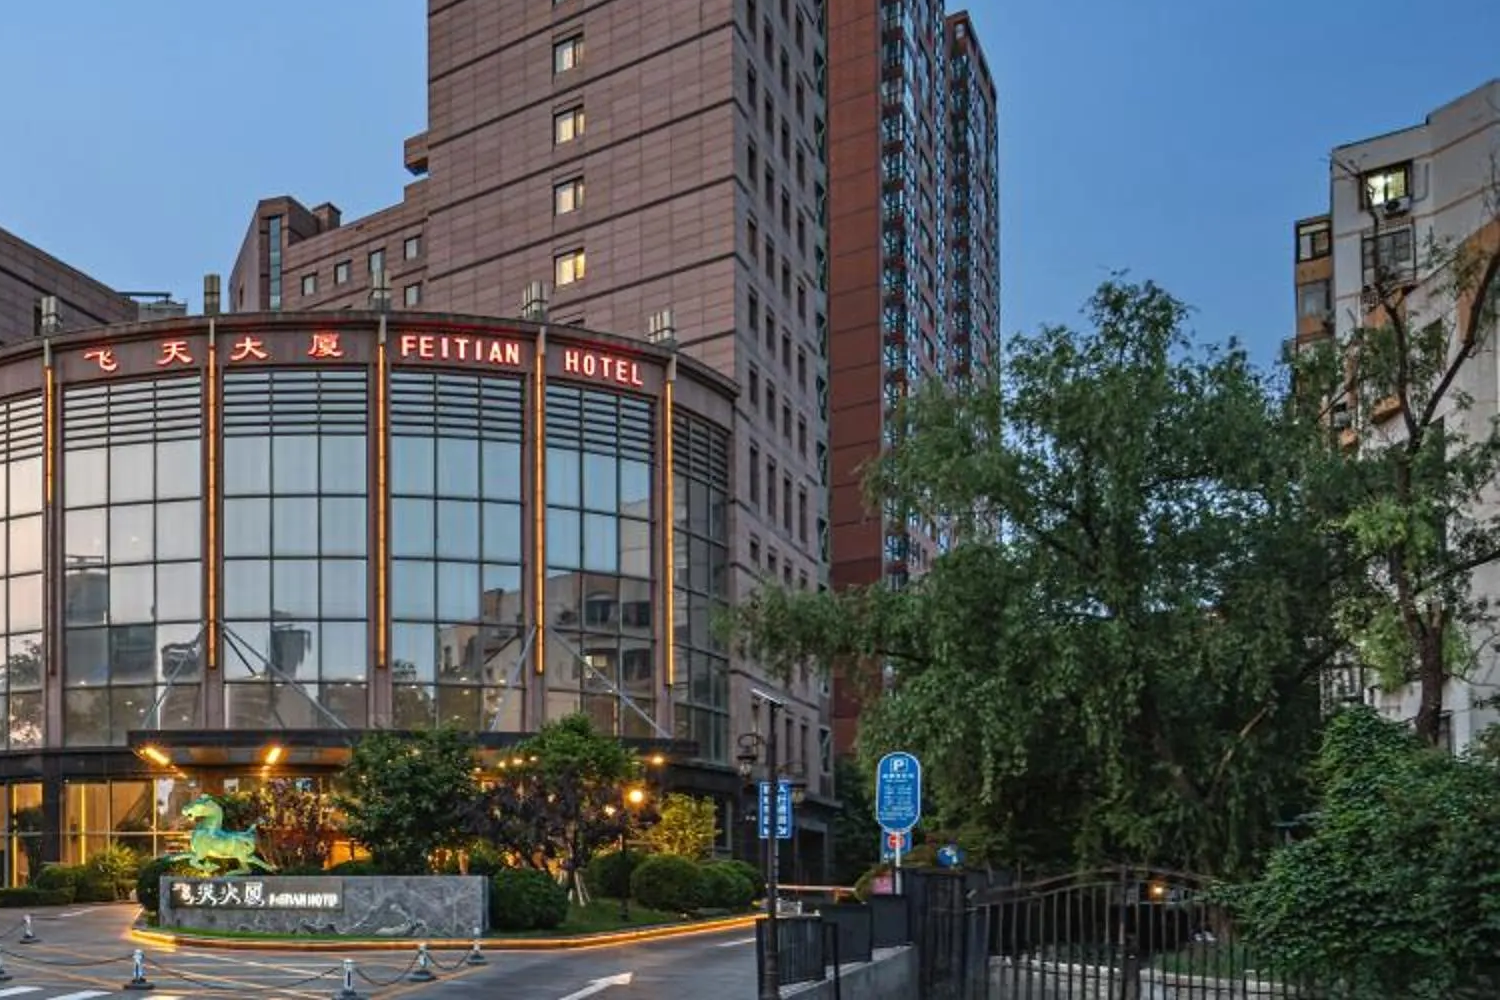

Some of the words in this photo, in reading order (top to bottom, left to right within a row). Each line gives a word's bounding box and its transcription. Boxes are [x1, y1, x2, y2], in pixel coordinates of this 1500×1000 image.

[84, 333, 343, 372] 飞天大厦
[401, 335, 520, 365] FEITIAN
[565, 350, 644, 386] HOTEL
[893, 759, 905, 772] P
